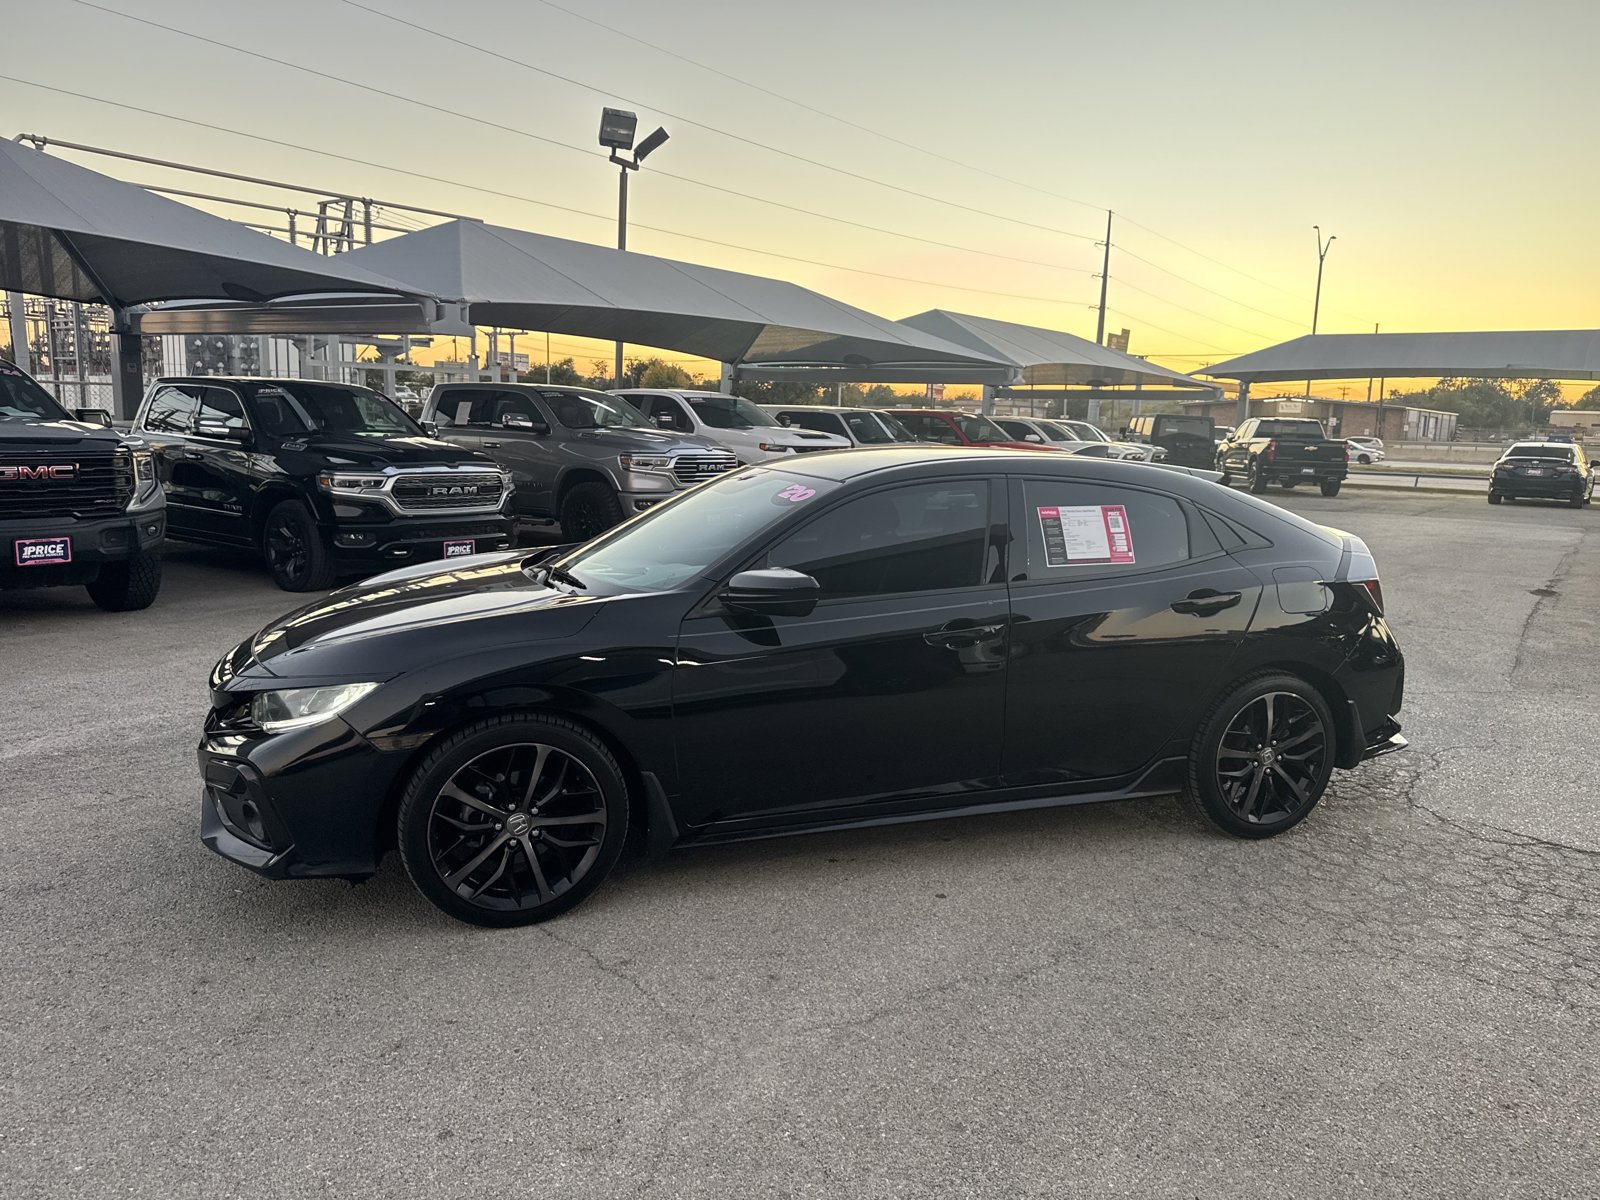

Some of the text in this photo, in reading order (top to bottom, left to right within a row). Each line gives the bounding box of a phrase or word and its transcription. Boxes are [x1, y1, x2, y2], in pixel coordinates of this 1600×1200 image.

[0, 465, 74, 480] GMC
[432, 486, 478, 495] RAM
[22, 543, 65, 557] 1PRICE
